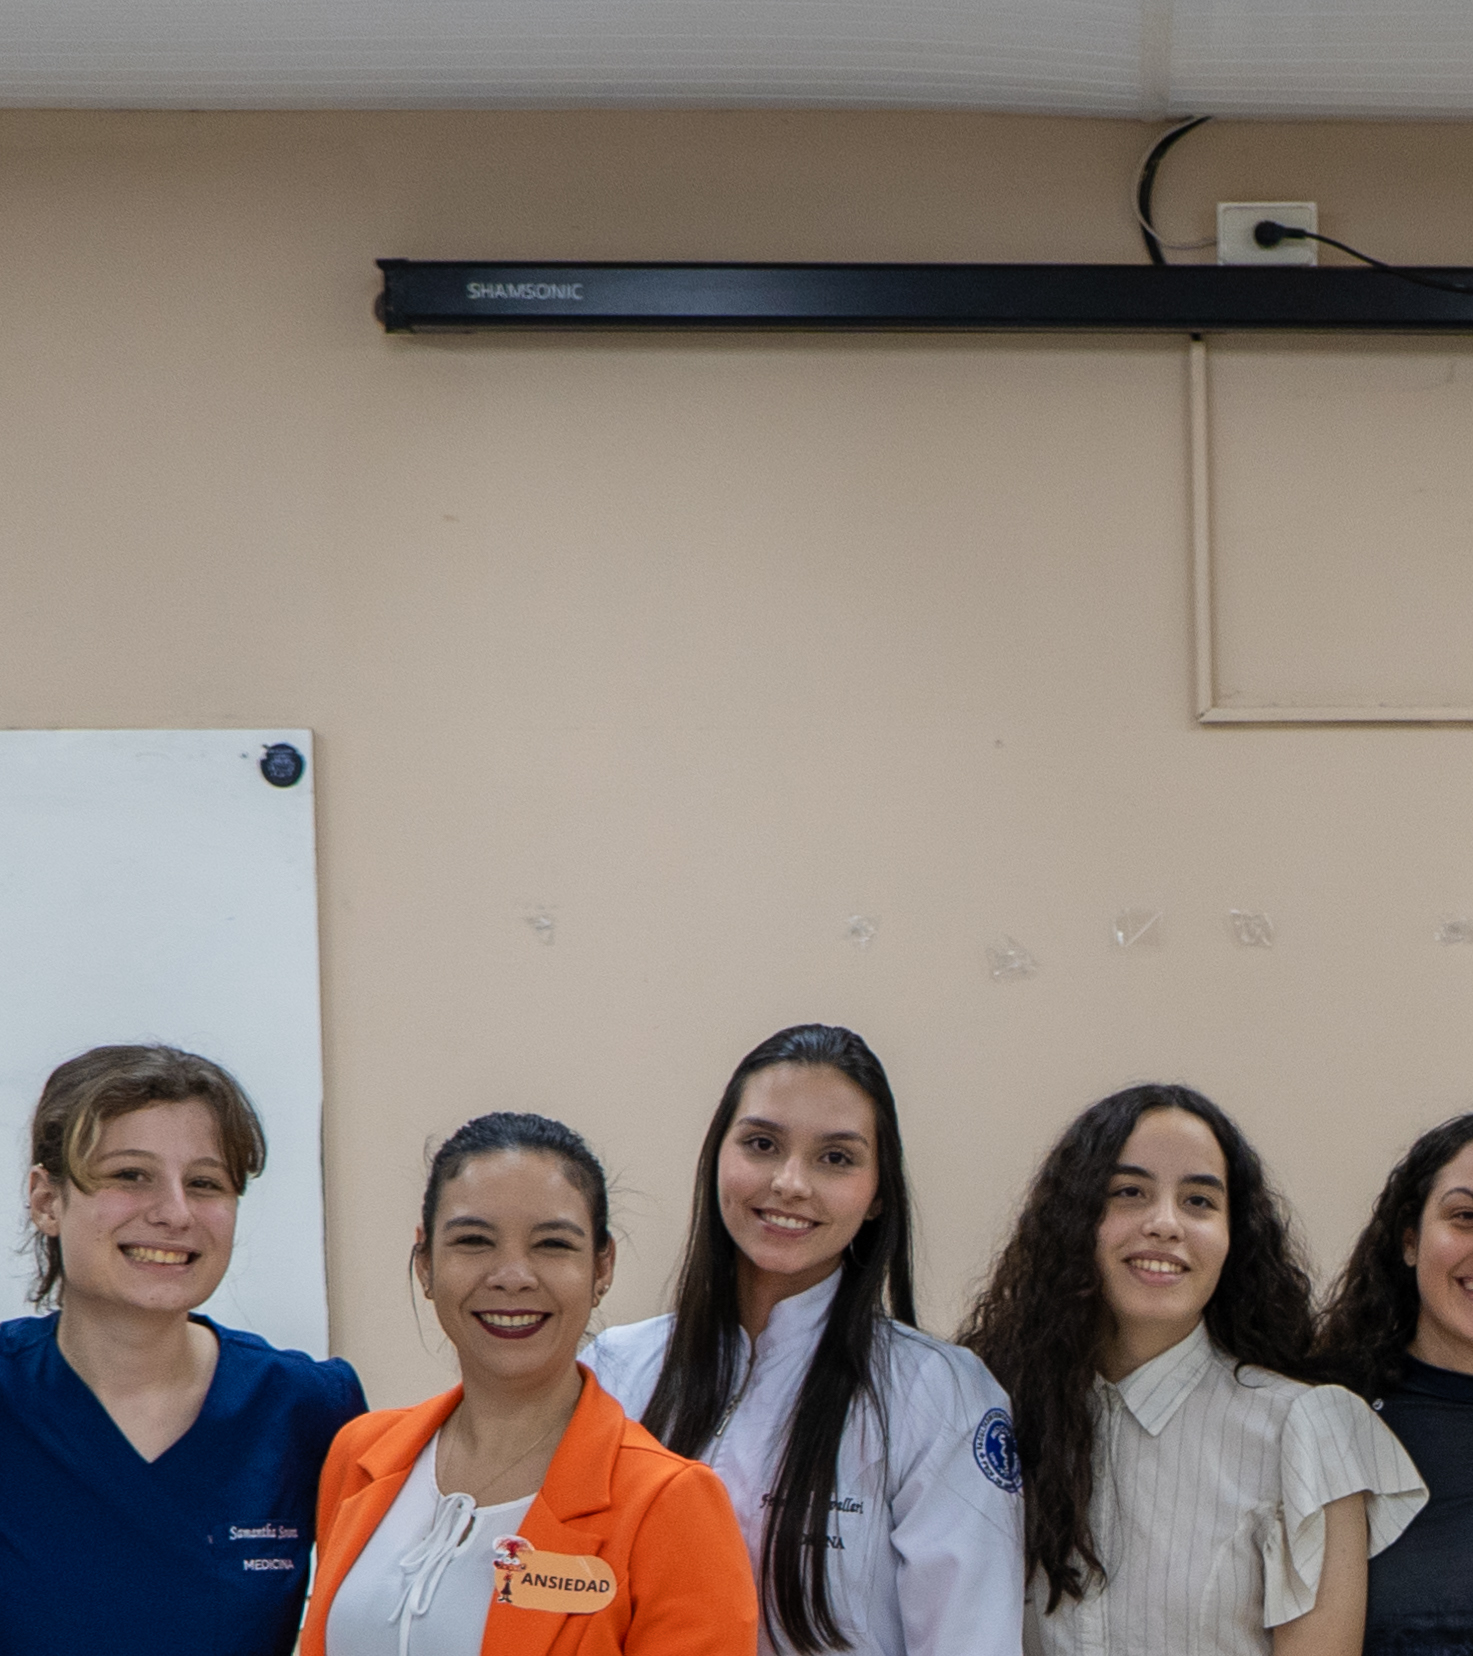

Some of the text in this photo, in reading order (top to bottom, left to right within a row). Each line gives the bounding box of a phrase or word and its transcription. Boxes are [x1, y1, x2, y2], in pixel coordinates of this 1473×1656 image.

[467, 282, 584, 300] SHAMSONIC
[243, 1559, 295, 1571] MEDICINA
[521, 1572, 610, 1594] ANSIEDAD
